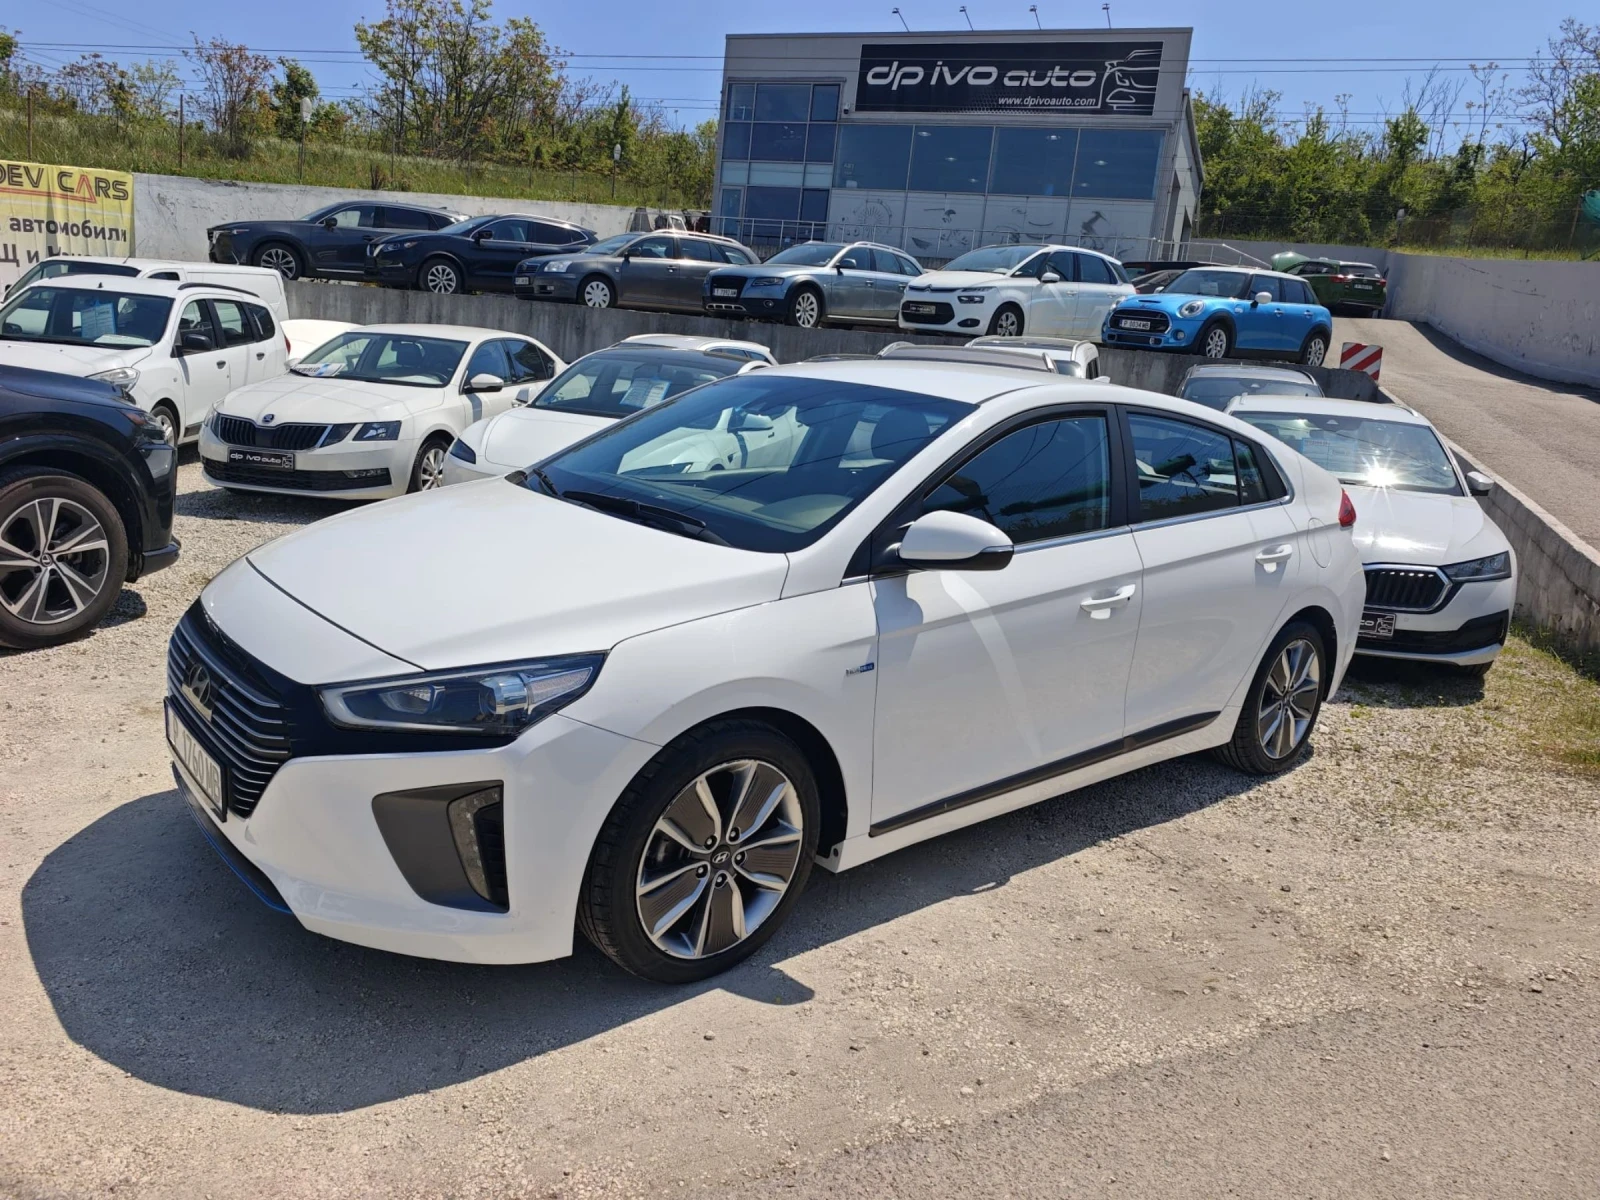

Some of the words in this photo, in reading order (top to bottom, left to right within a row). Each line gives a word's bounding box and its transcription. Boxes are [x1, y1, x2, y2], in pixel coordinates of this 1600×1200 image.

[866, 61, 924, 90] dp
[930, 61, 998, 86] ivo
[1003, 65, 1096, 87] auto
[998, 95, 1096, 107] www.dpivoauto.com
[57, 171, 129, 203] CARS
[9, 217, 127, 242] автомобили
